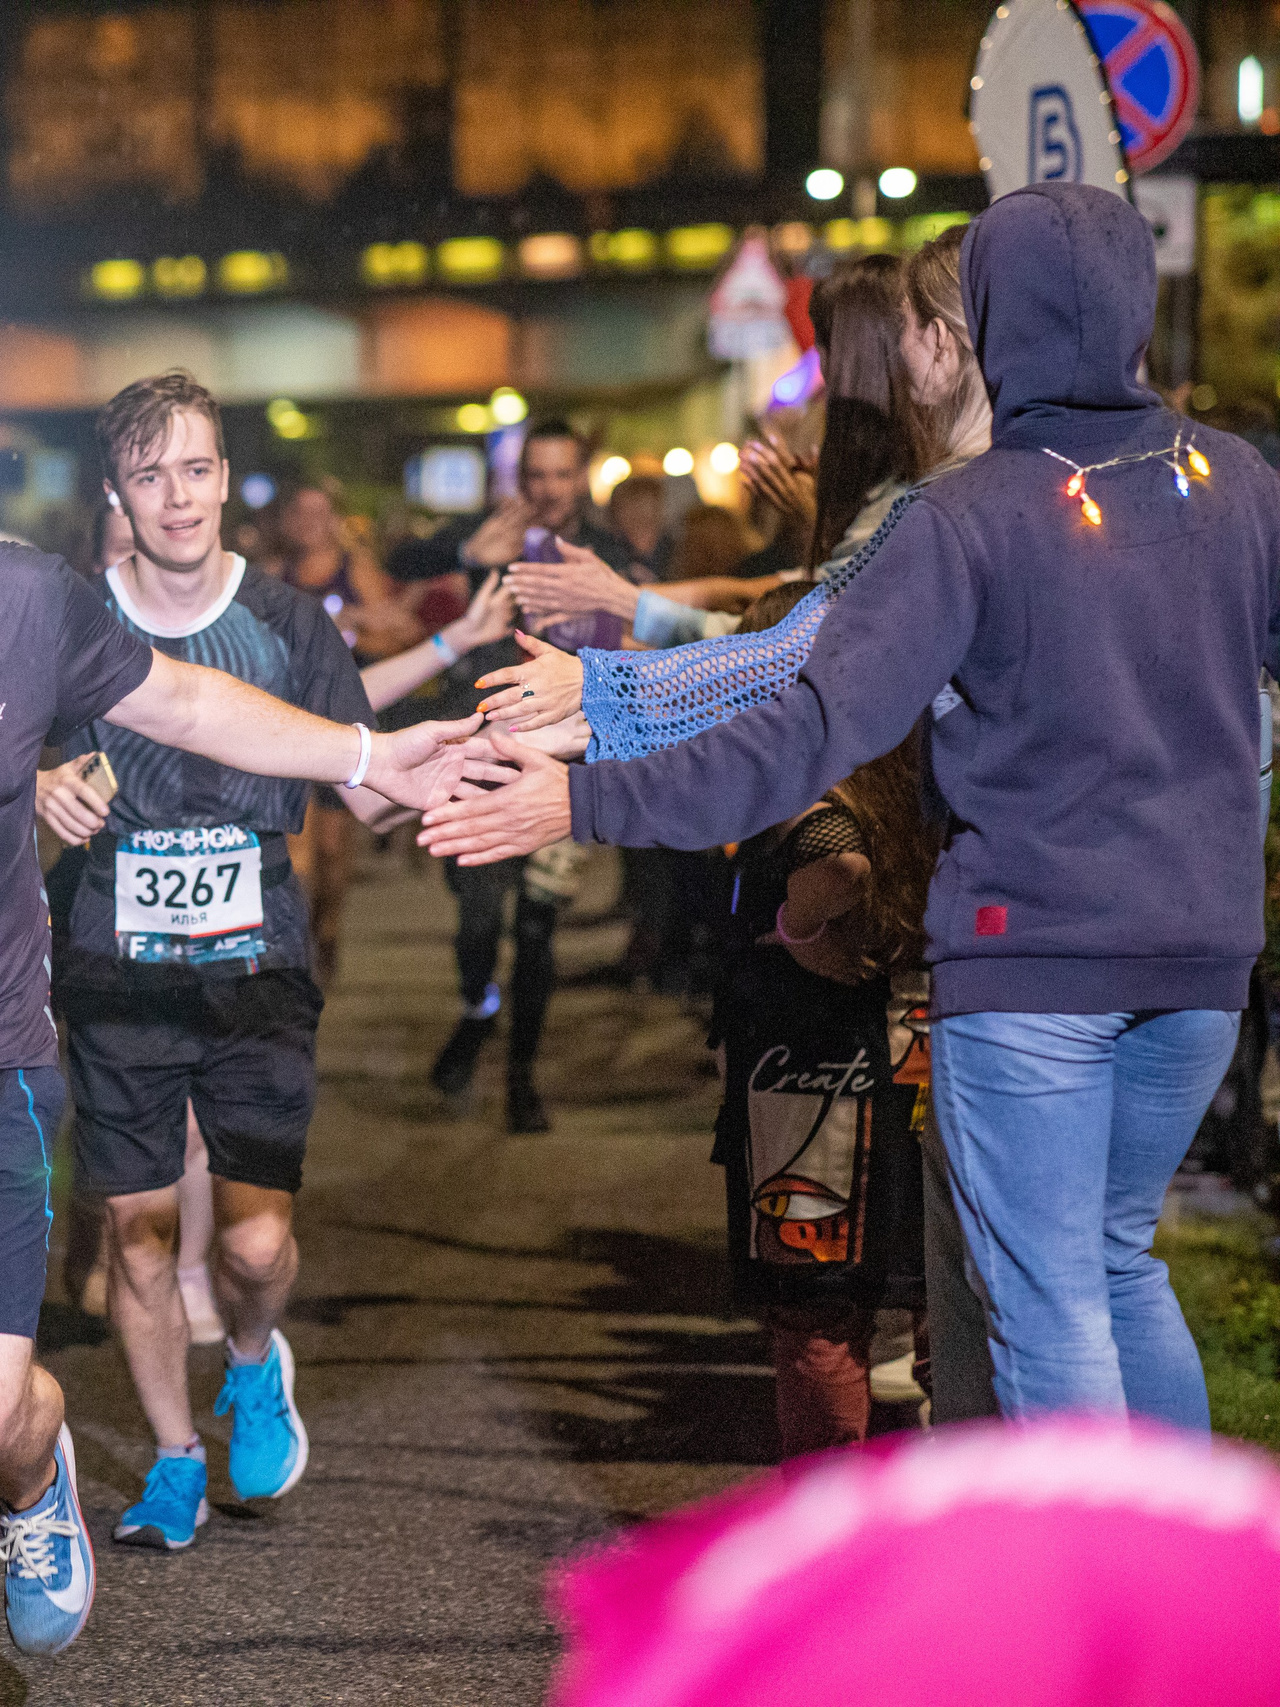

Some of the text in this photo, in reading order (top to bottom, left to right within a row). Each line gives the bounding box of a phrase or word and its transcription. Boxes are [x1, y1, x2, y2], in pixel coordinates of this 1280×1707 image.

[135, 862, 242, 909] 3267
[170, 912, 208, 926] ИЛЬЯ
[129, 936, 147, 959] F
[747, 1045, 875, 1098] Create
